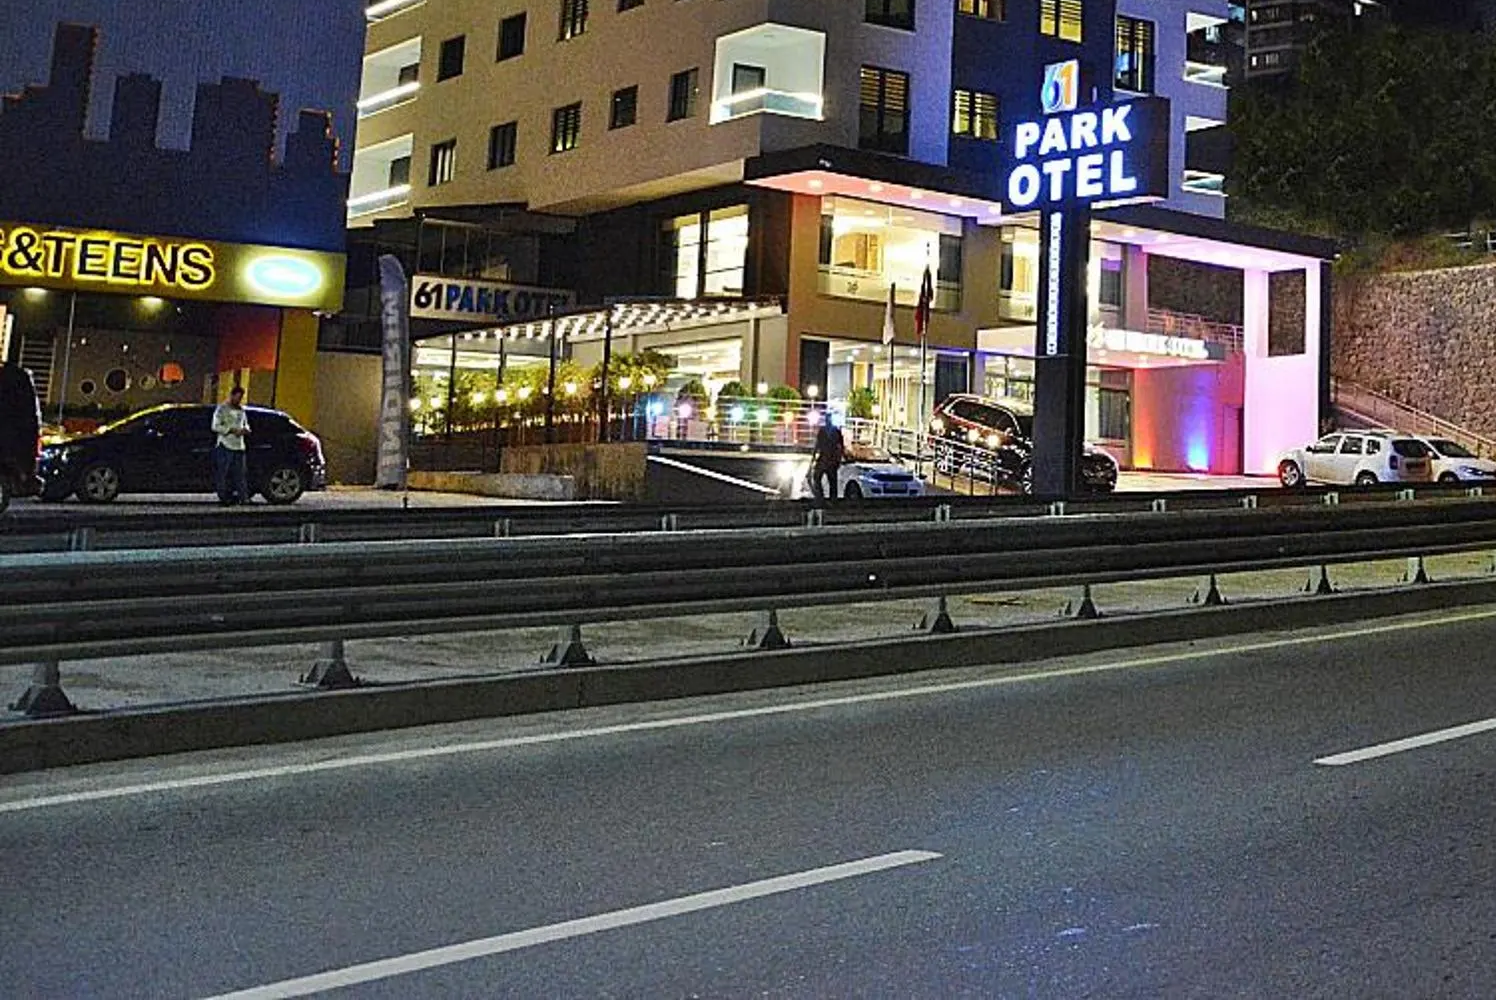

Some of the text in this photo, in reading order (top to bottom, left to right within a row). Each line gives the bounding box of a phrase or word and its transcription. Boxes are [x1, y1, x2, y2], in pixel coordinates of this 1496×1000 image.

[1041, 62, 1075, 112] 61
[1015, 104, 1132, 160] PARK
[1008, 150, 1137, 206] OTEL
[0, 228, 214, 287] &TEENS
